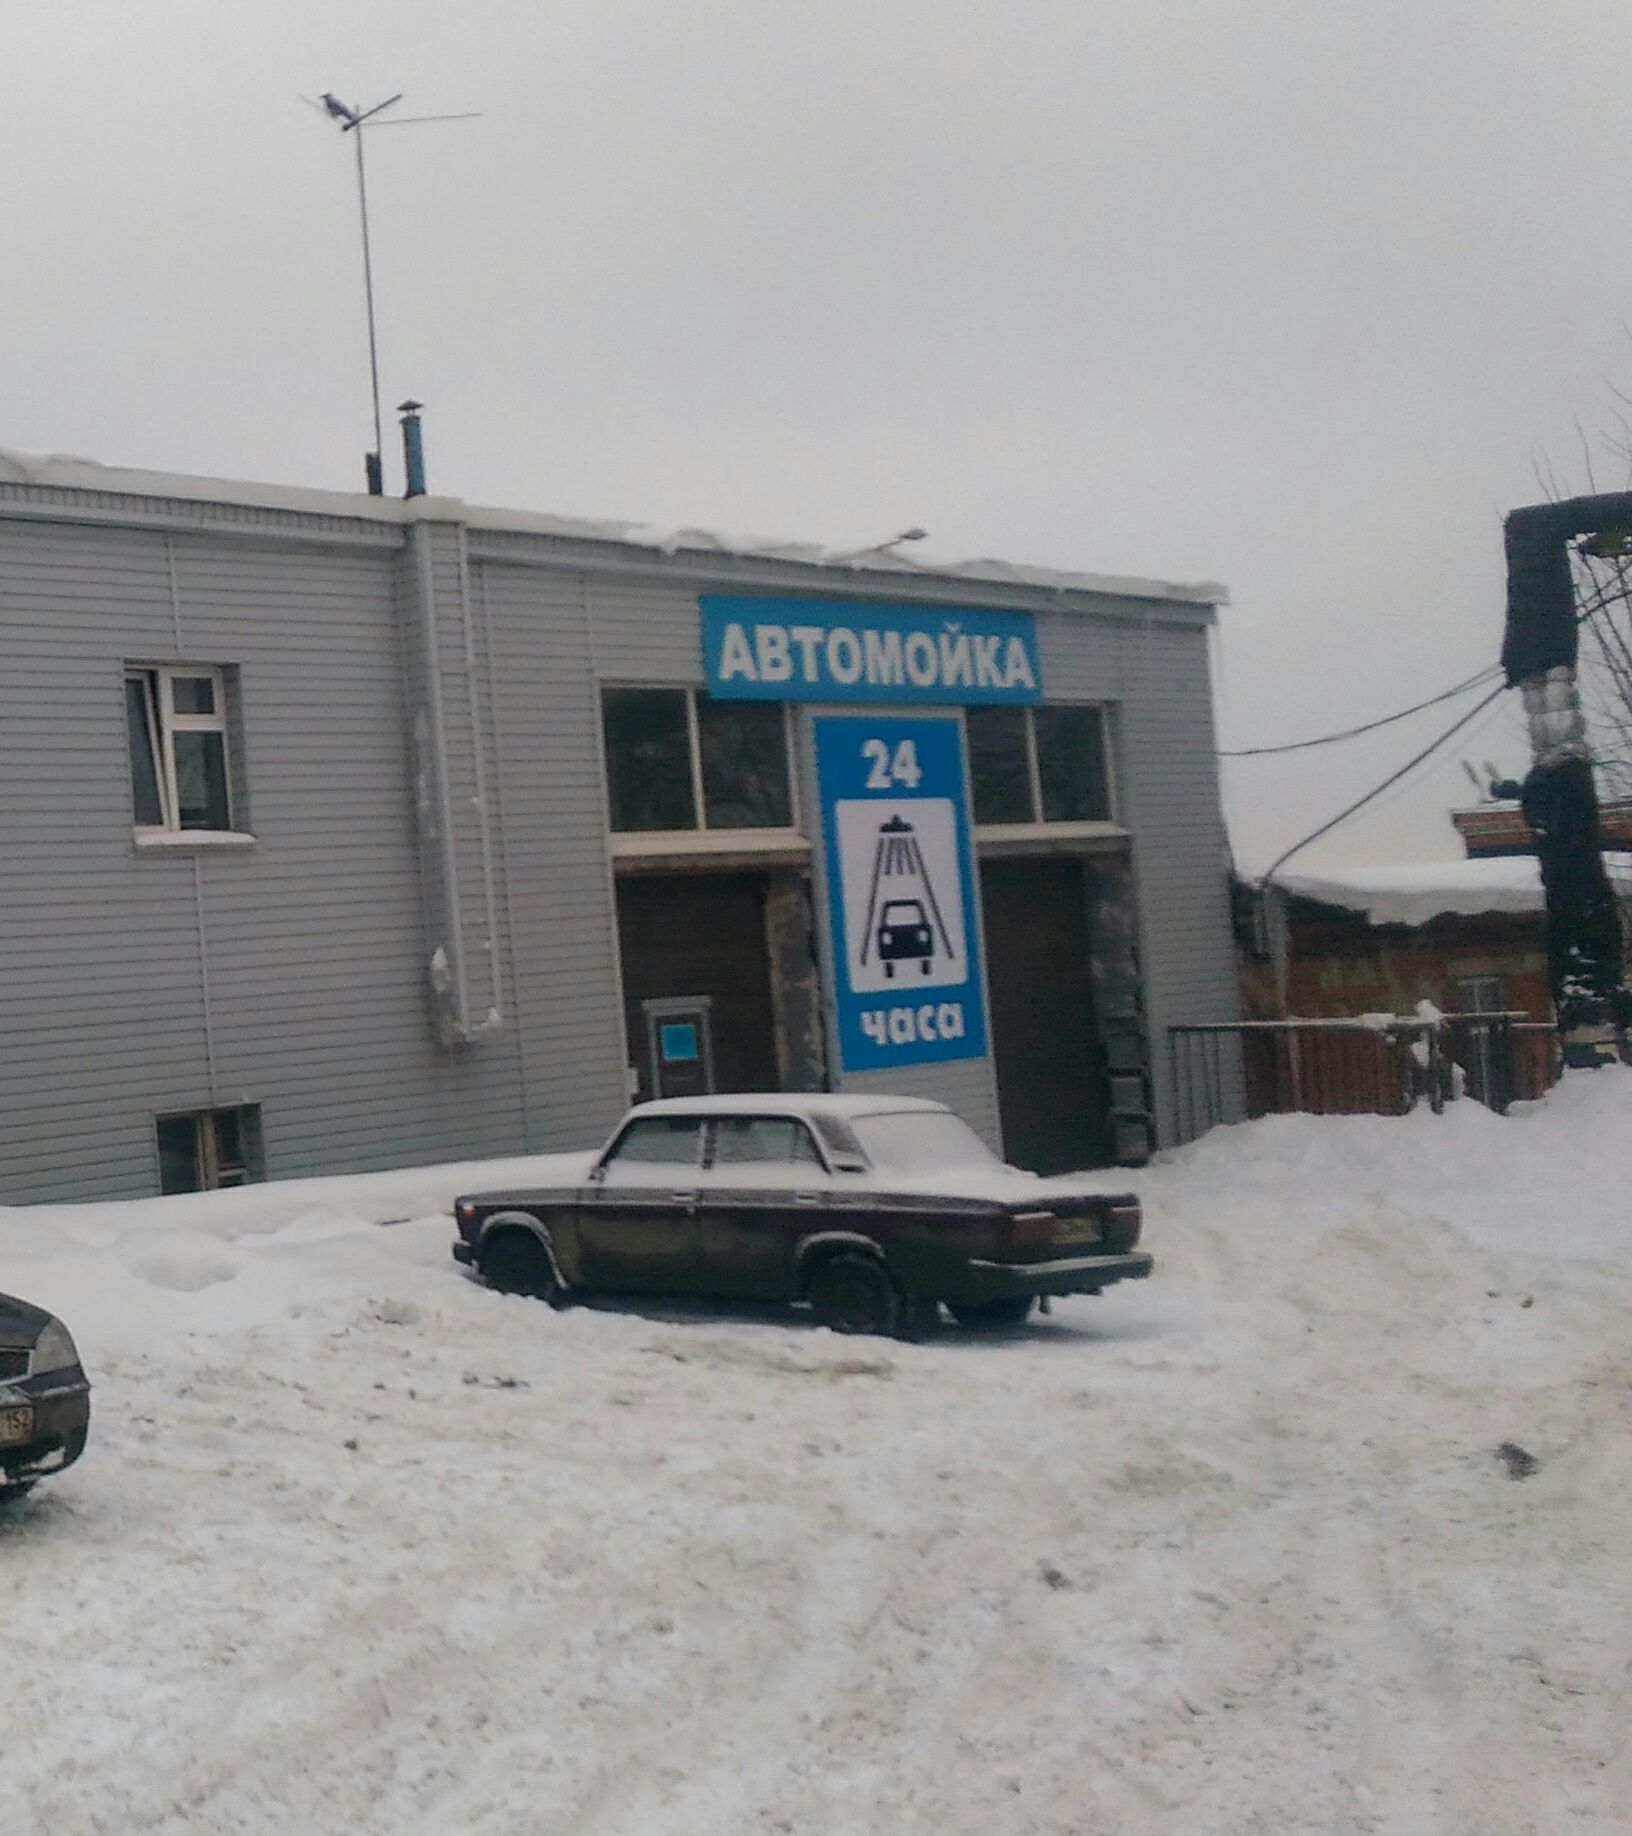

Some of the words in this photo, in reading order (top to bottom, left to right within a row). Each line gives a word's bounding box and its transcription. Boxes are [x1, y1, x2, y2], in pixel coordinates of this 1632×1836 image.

[719, 611, 1036, 688] АВТОМОЙКА
[861, 738, 922, 789] 24
[860, 1002, 966, 1045] часа
